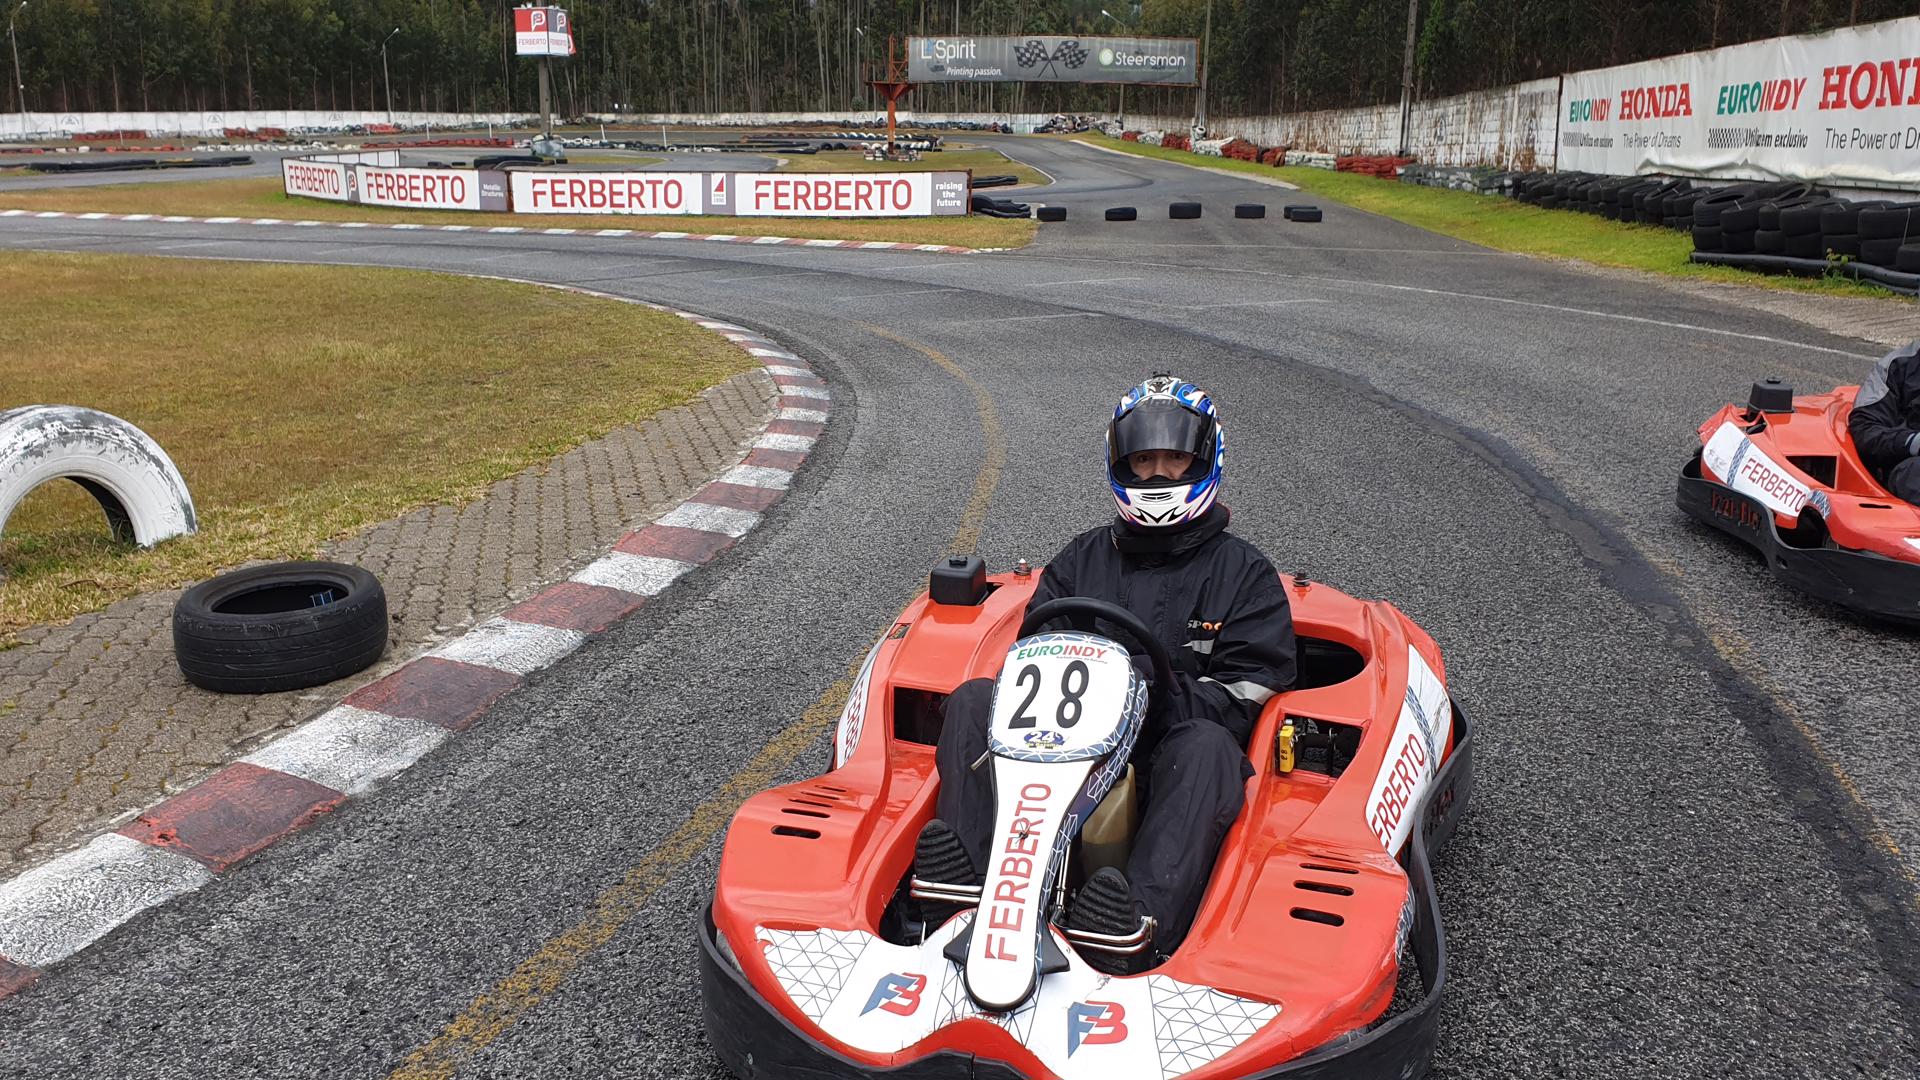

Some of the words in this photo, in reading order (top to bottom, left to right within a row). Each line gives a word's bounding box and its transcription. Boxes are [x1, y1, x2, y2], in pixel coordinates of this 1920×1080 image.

[946, 67, 974, 77] Printing
[1115, 51, 1186, 66] Steersman
[1619, 83, 1692, 120] HONDA
[1716, 77, 1808, 115] EUROINDY
[1774, 126, 1808, 148] exclusivo
[1825, 128, 1847, 149] The
[1850, 128, 1887, 149] Power
[288, 165, 340, 195] FERBERTO
[365, 172, 465, 204] FERBERTO
[532, 179, 682, 209] FERBERTO
[755, 179, 912, 210] FERBERTO
[935, 181, 963, 191] raising
[942, 190, 956, 199] the
[936, 199, 961, 208] future
[1741, 458, 1807, 514] FERBERTO
[1016, 645, 1108, 661] EUROINDY
[1008, 659, 1089, 729] 28
[984, 783, 1052, 962] FERBERTO
